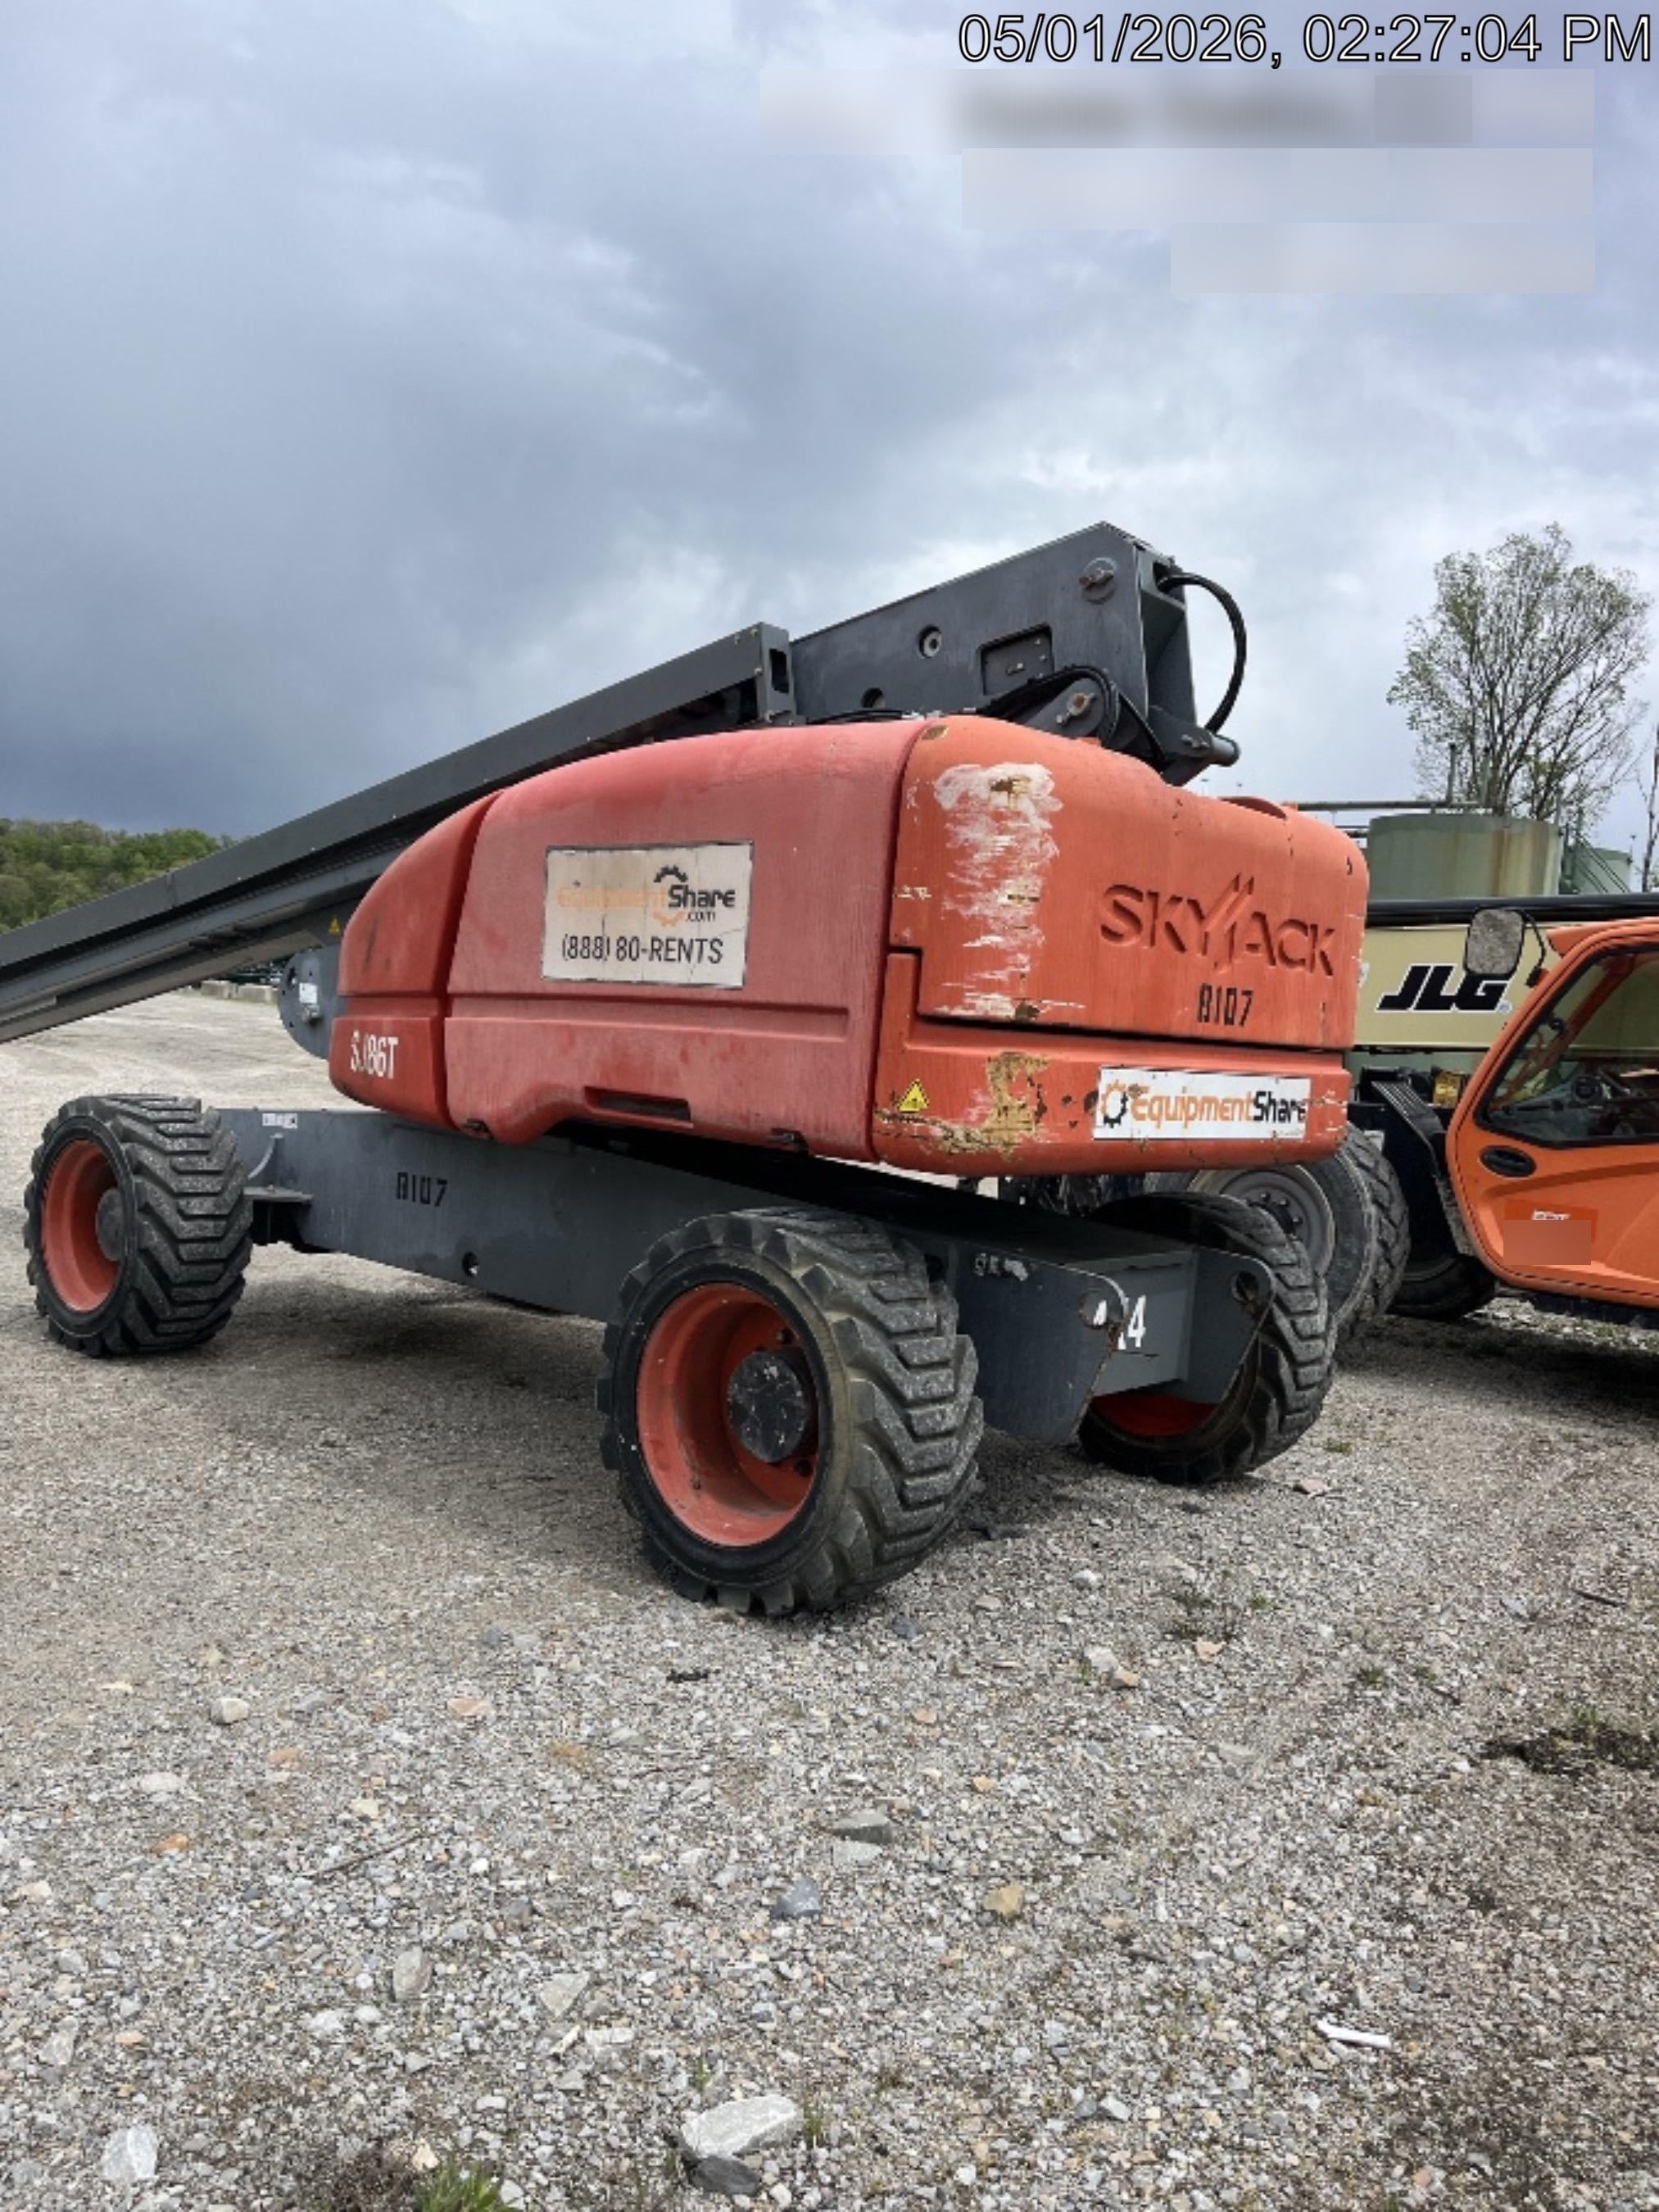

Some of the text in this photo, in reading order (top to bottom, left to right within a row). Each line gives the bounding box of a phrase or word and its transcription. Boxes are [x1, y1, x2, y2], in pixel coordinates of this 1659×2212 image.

[1101, 873, 1335, 977] SKYJACK
[562, 934, 724, 964] (888) 80-RENTS
[1376, 964, 1512, 1012] JLG
[1128, 1083, 1307, 1129] EquipmentShare
